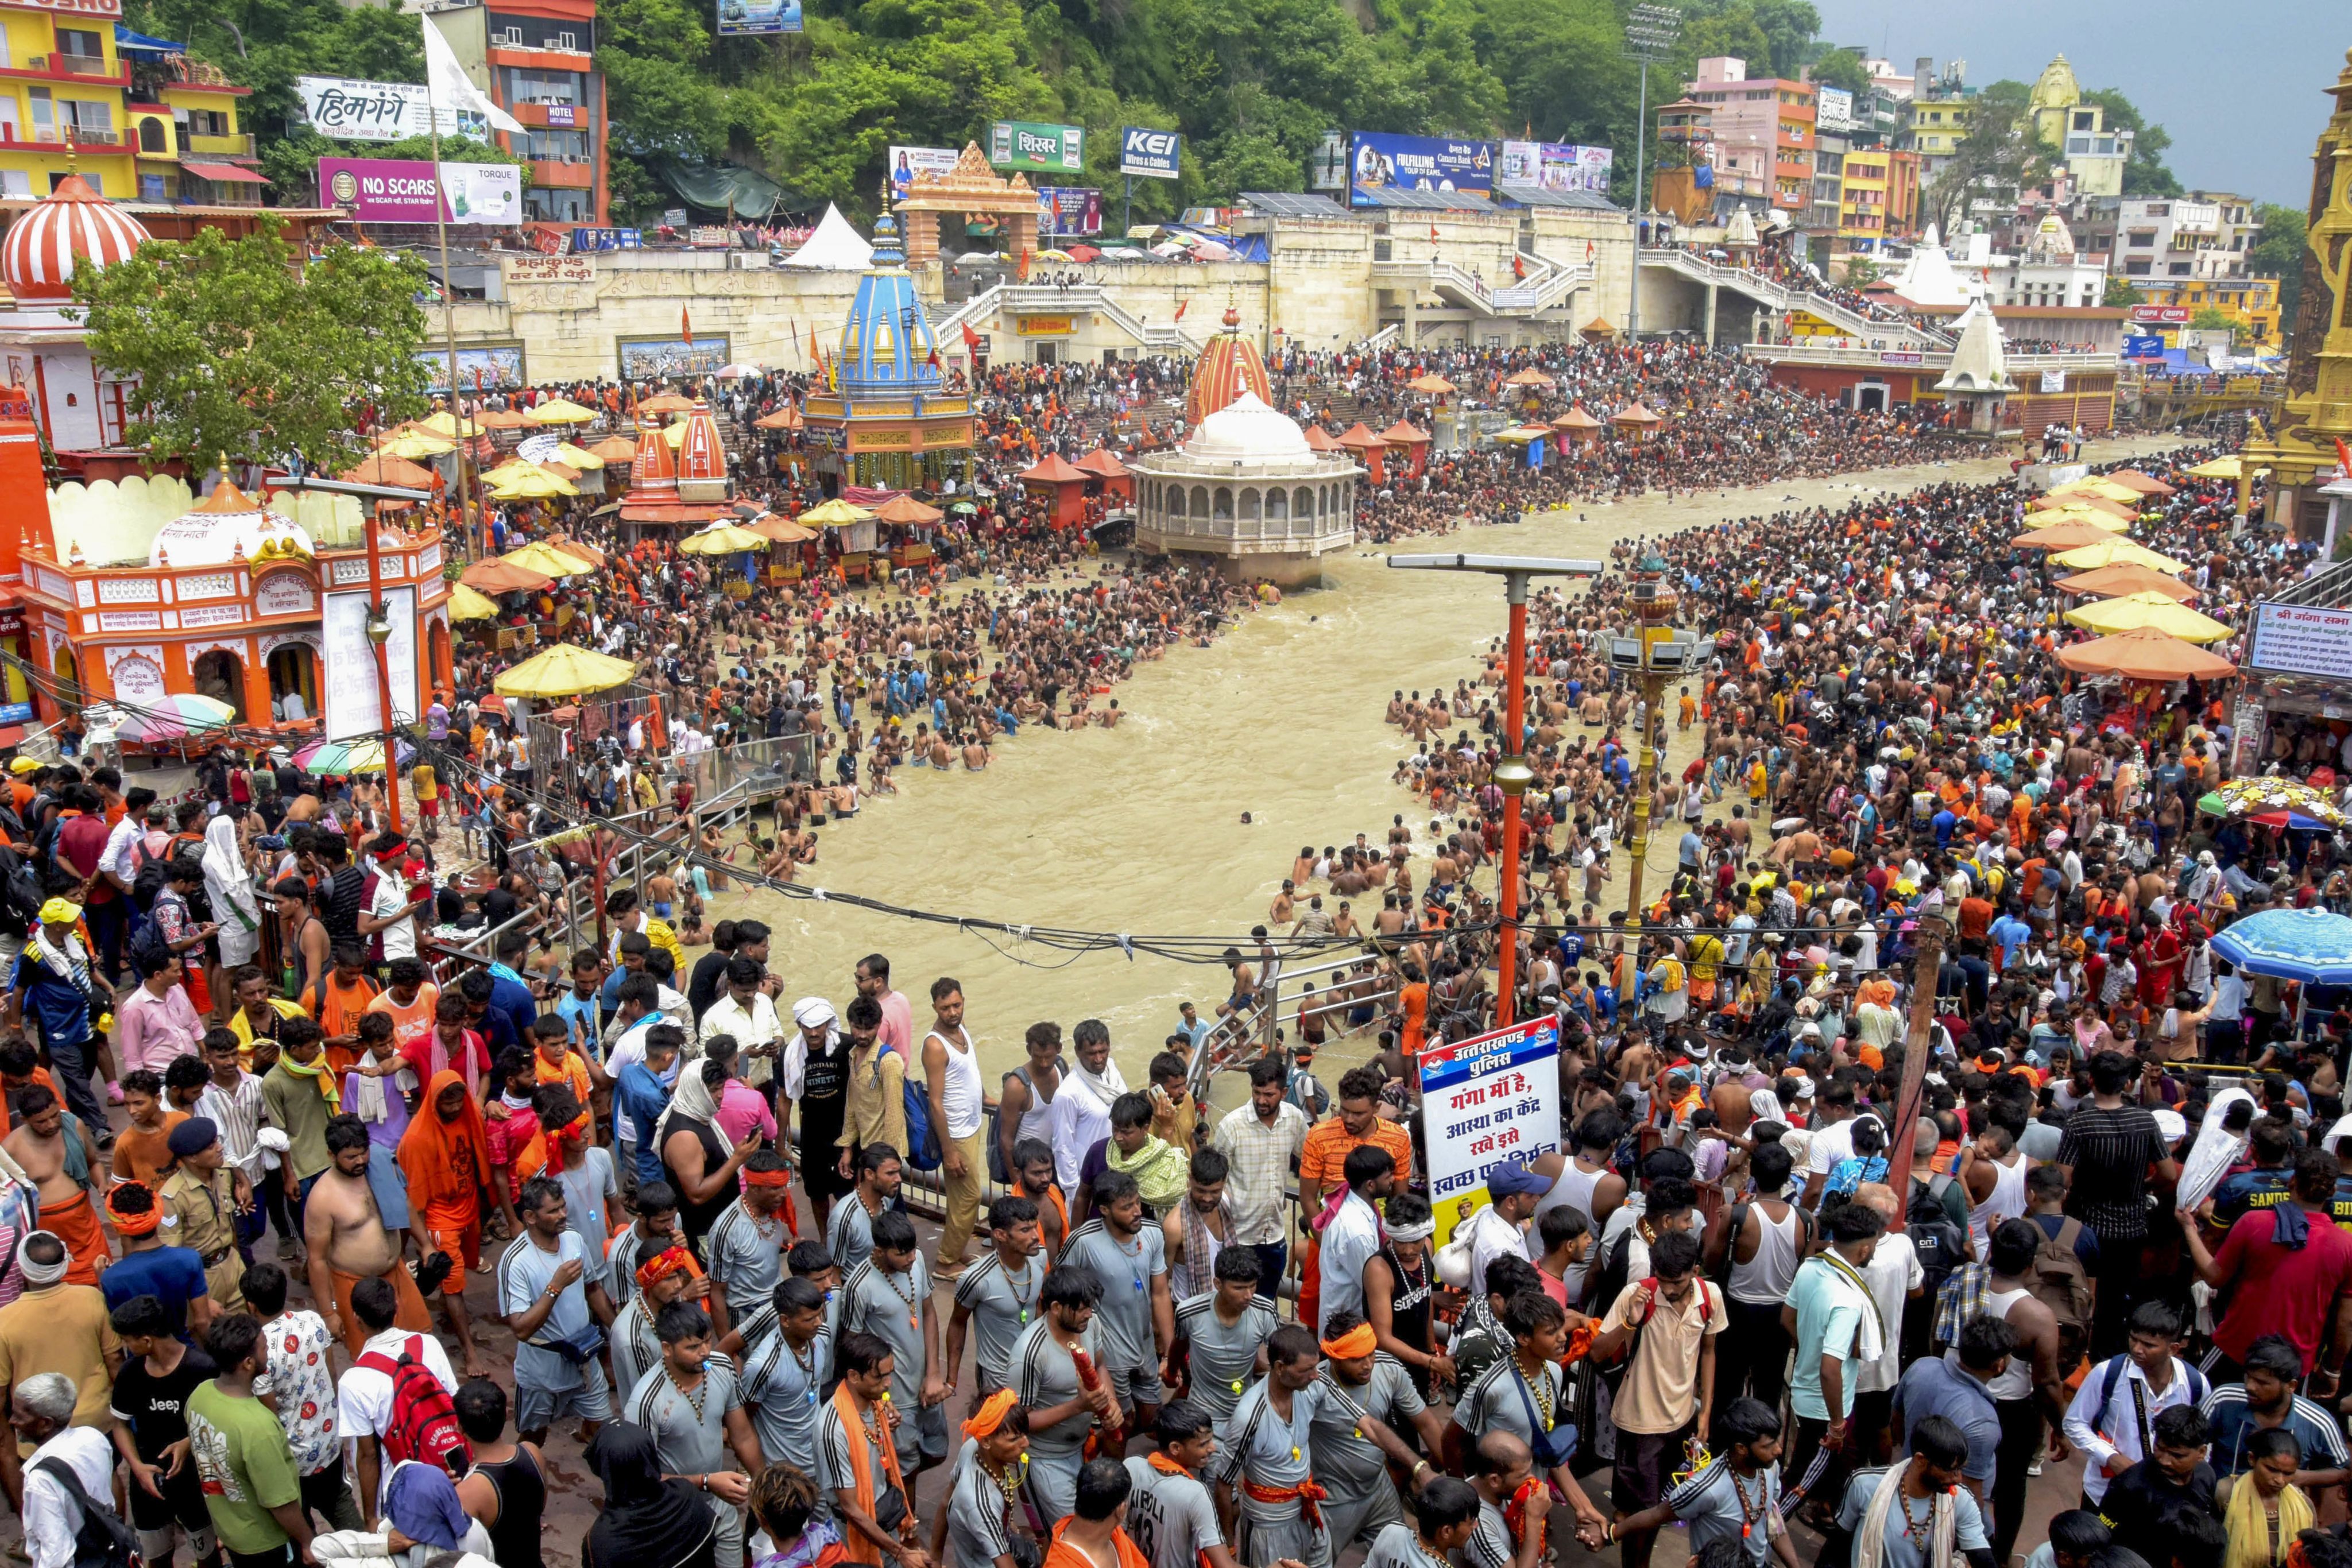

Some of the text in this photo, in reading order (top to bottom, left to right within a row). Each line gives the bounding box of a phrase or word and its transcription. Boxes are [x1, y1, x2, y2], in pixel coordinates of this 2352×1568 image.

[314, 88, 407, 126] हिमगंगे
[549, 107, 572, 117] HOTEL
[1018, 131, 1057, 153] शिखर
[1127, 131, 1175, 155] KEI
[1125, 154, 1170, 169] Wires & Cables
[1396, 153, 1434, 168] FULFILLING
[1437, 153, 1471, 165] Canara Bank
[479, 170, 512, 179] TORQUE
[363, 177, 436, 196] NO SCARS
[536, 270, 558, 279] की
[2276, 609, 2350, 625] श्री गंगा सभा
[260, 635, 280, 657] आरती
[667, 663, 672, 672] 2
[1453, 1029, 1526, 1062] उत्तराखण्ड
[1469, 1052, 1511, 1078] पुलिस
[1450, 1087, 1486, 1110] गंगा
[1446, 1097, 1541, 1140] आस्था का केंद्र
[1469, 1127, 1519, 1156] रखें इसे
[1433, 1170, 1475, 1195] स्वच्छ
[149, 1398, 179, 1414] Jeep
